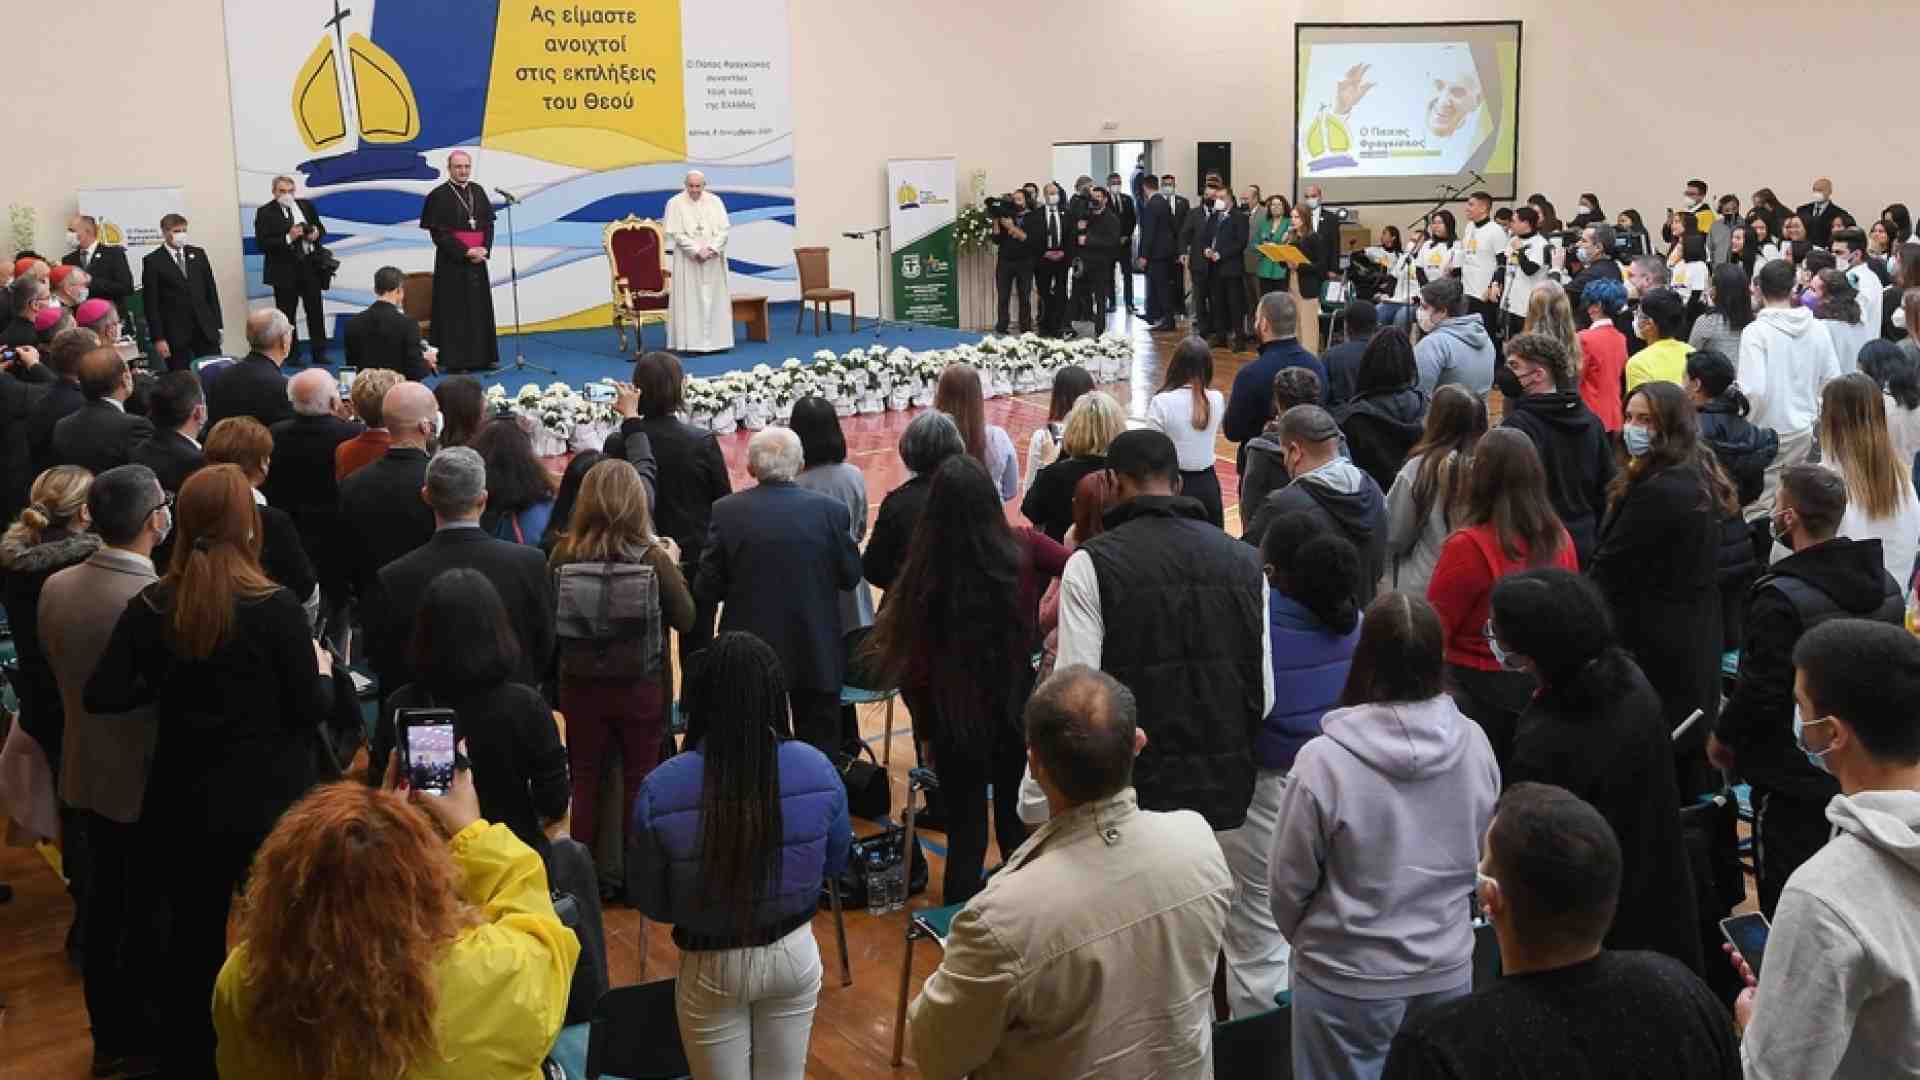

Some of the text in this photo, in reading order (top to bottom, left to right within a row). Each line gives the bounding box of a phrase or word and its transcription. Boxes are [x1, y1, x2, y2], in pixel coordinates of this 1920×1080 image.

[530, 4, 638, 27] Ας είμαστε
[544, 33, 628, 56] ανοιχτοί
[515, 63, 657, 85] στις εκπλήξεις
[542, 91, 635, 110] του Θεού
